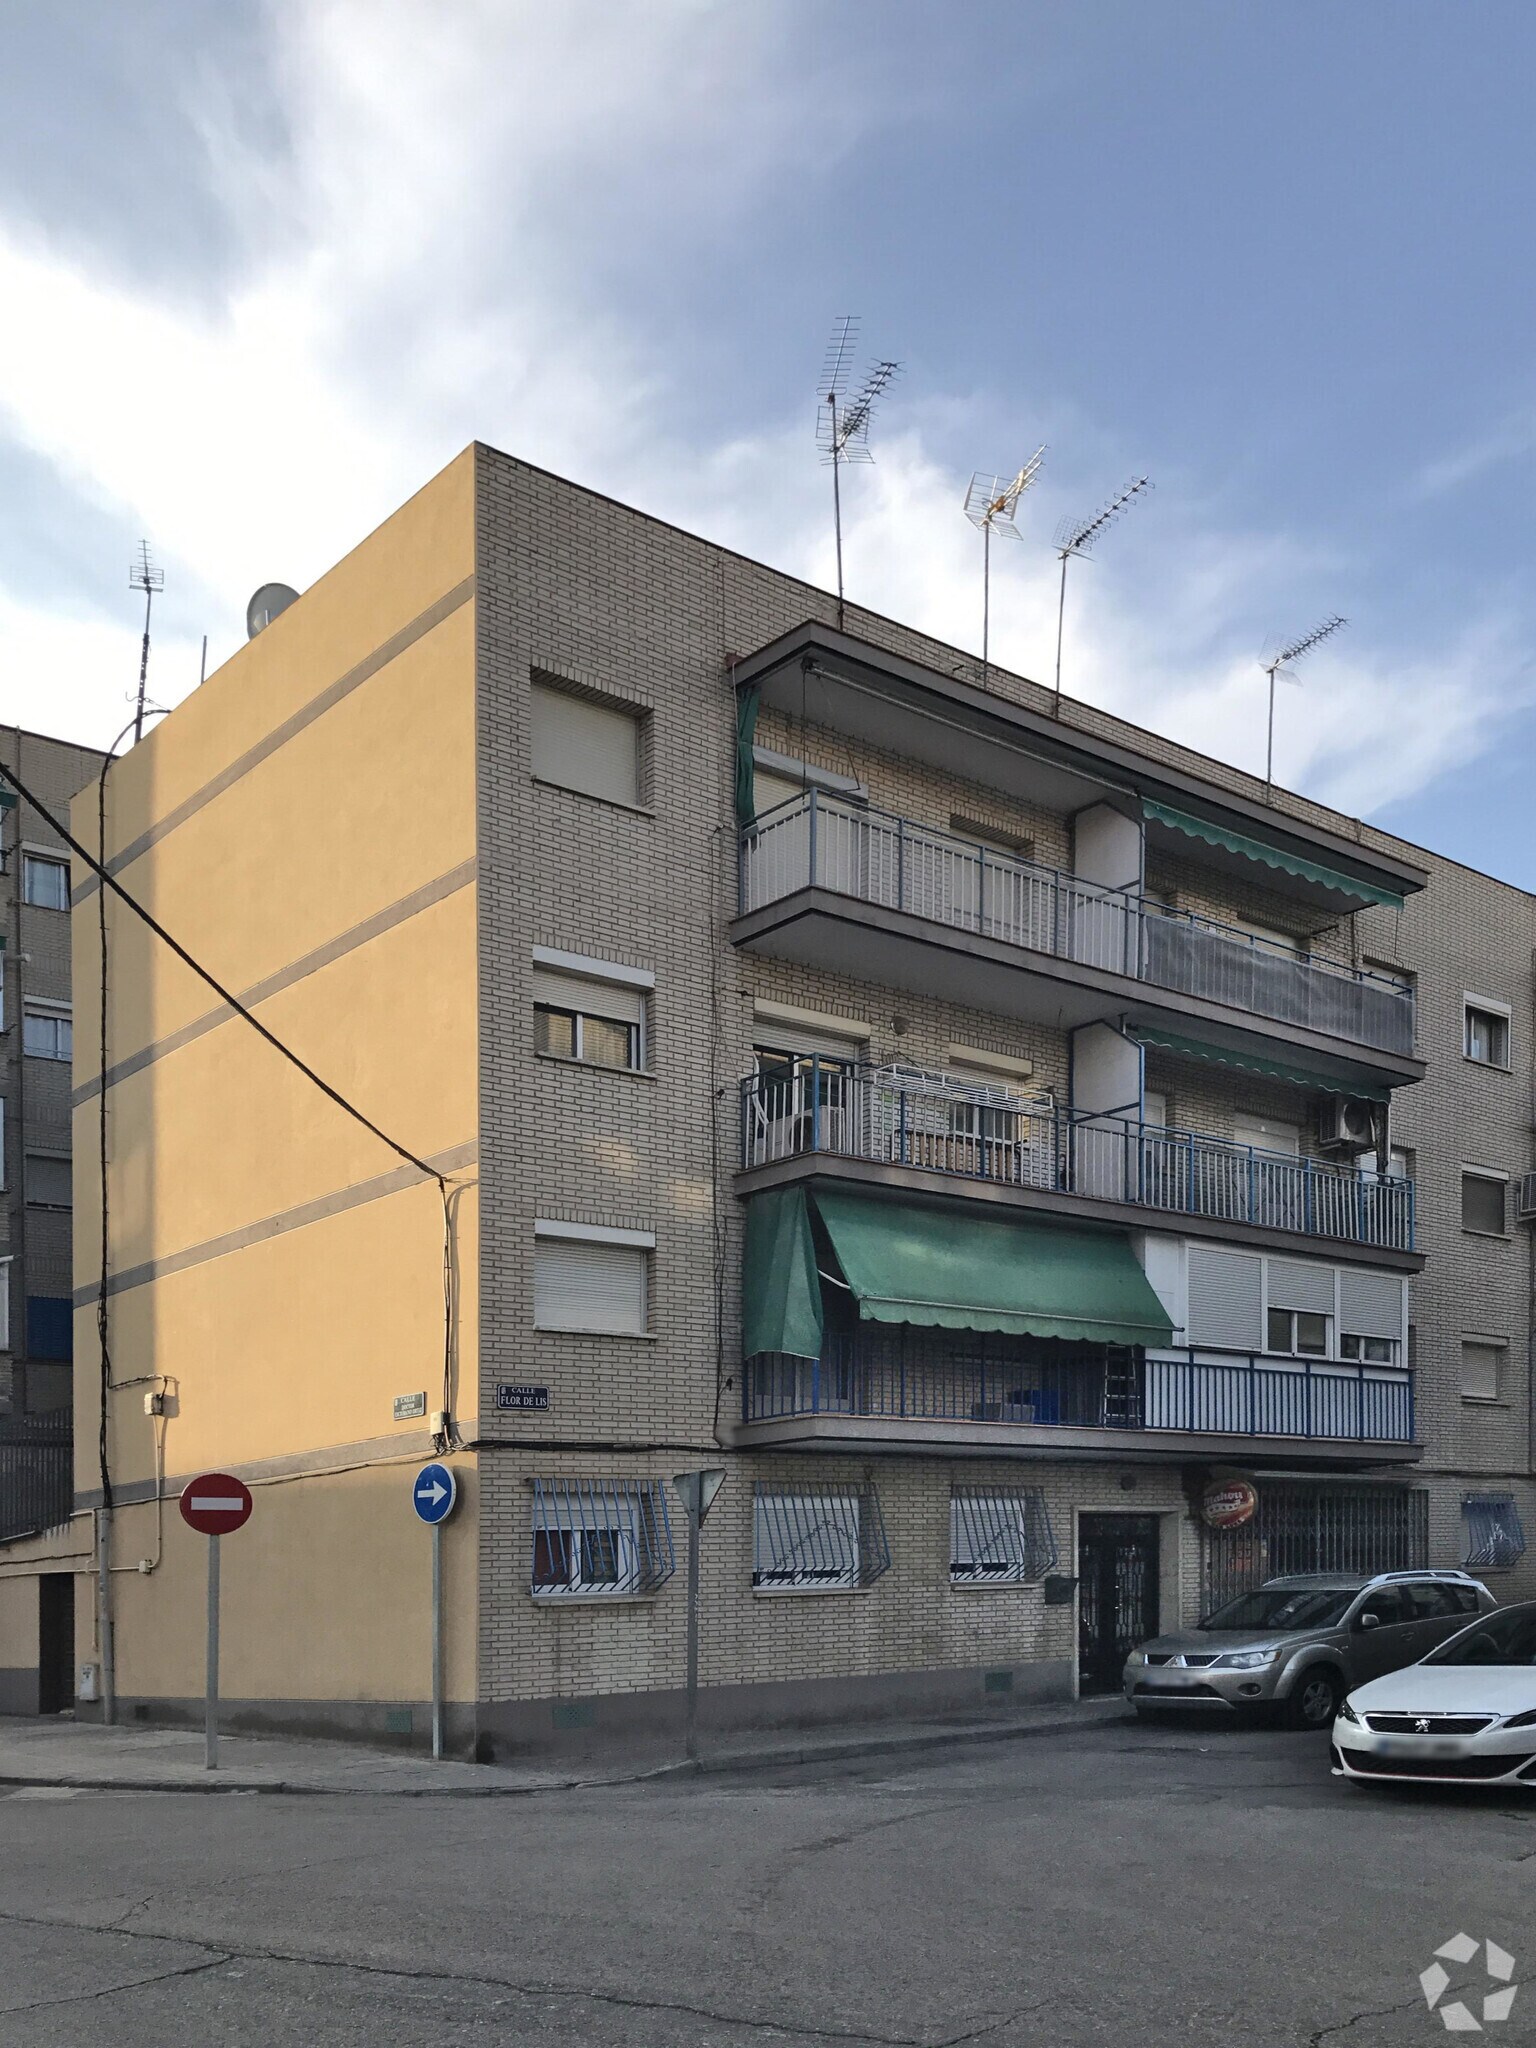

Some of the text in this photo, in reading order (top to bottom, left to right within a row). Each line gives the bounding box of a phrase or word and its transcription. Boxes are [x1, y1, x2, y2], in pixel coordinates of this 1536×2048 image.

[501, 1396, 547, 1406] FLOR DE LIS
